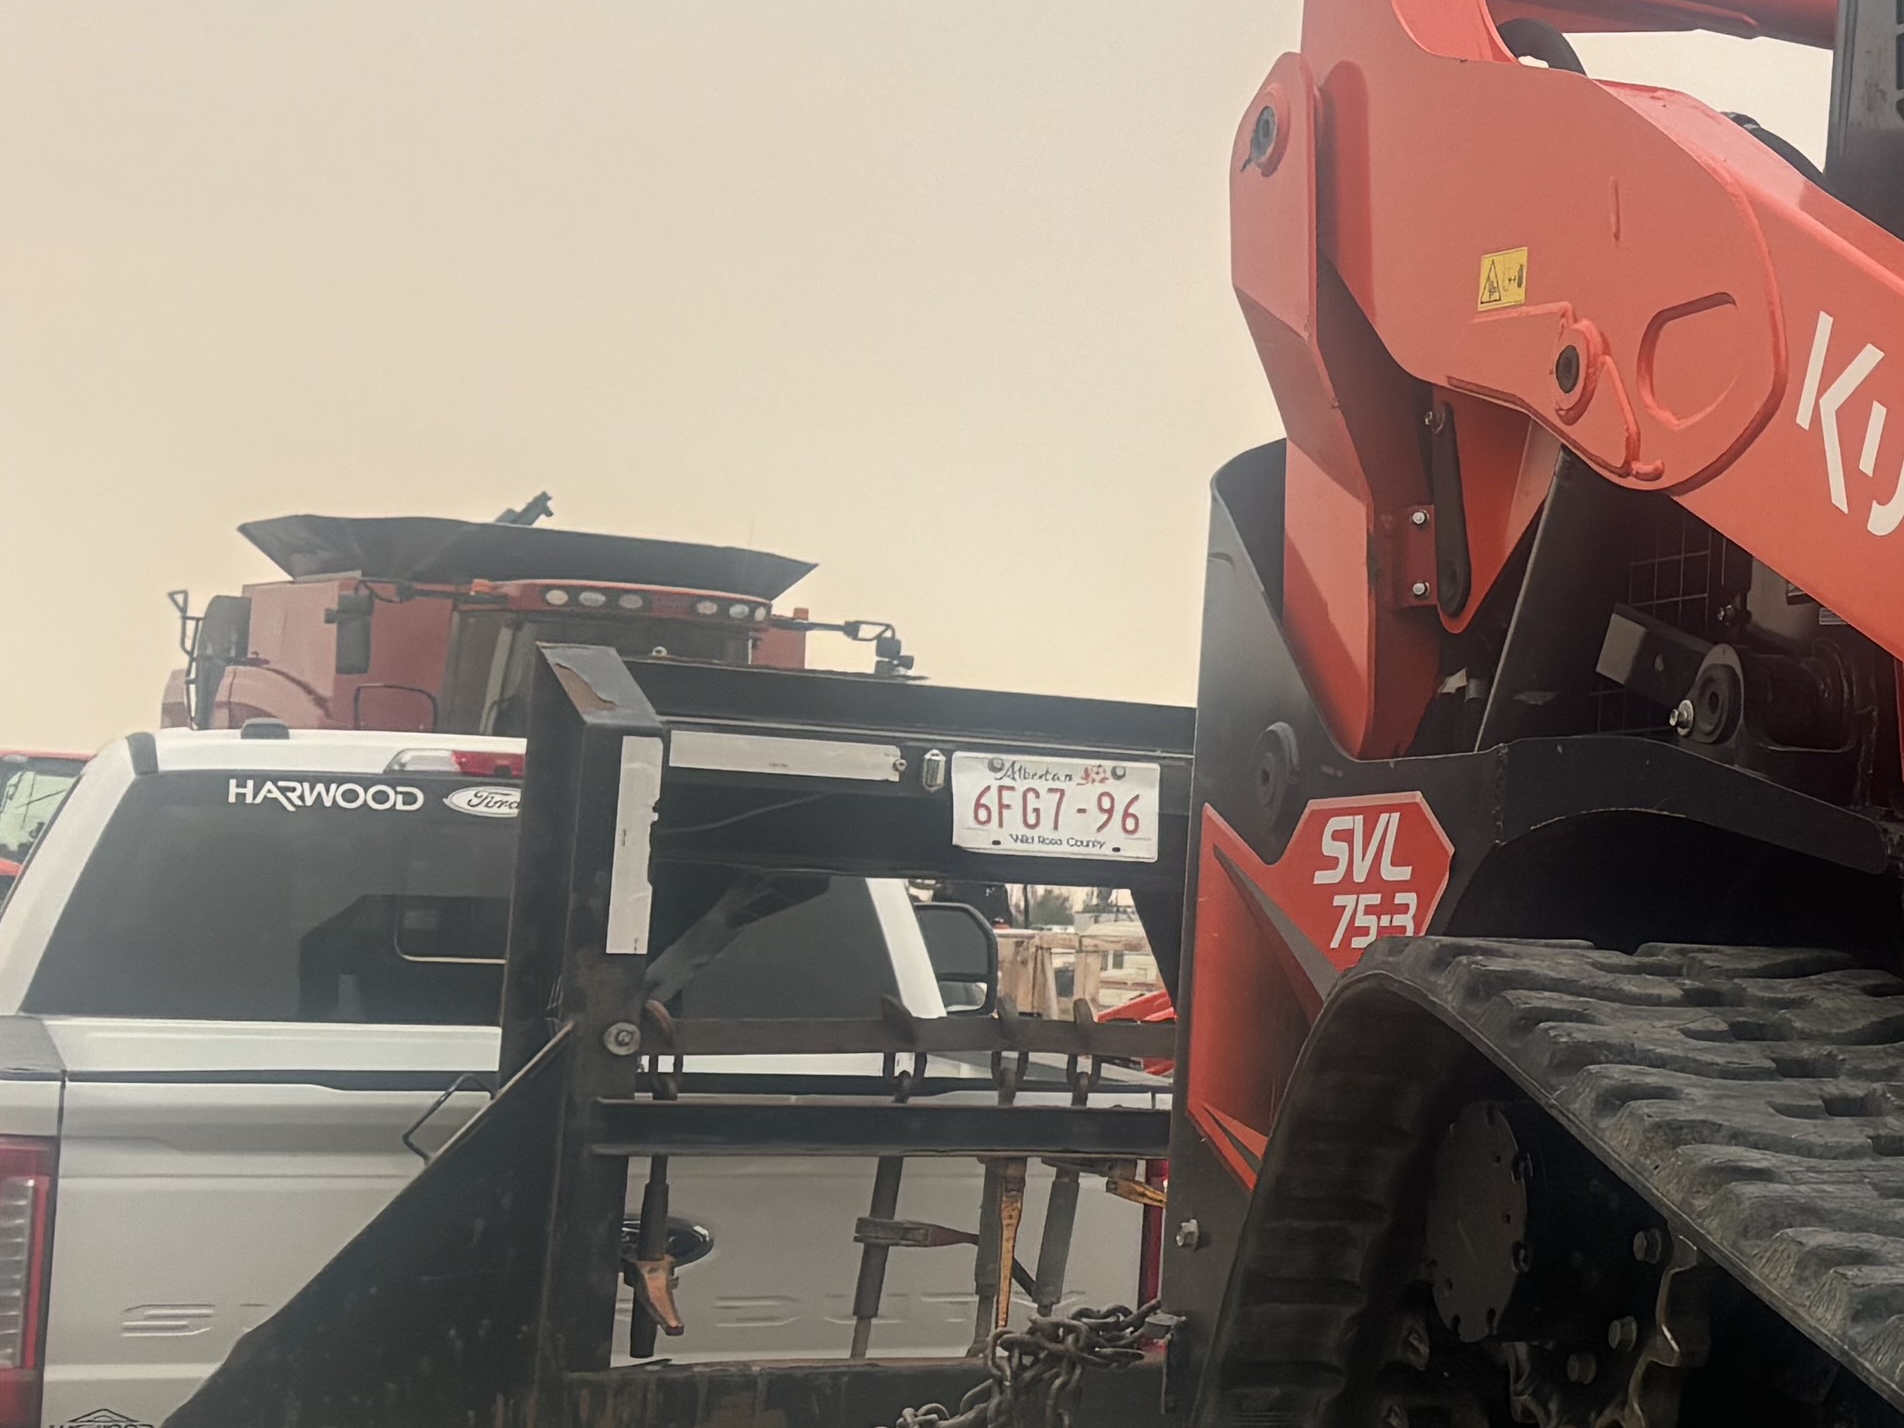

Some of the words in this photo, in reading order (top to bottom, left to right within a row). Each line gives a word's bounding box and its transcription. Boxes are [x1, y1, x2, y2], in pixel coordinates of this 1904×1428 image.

[228, 778, 424, 811] HARWOOD
[973, 784, 1141, 836] 6FG7-96
[1313, 812, 1413, 885] SVL
[1329, 892, 1418, 949] 75-3
